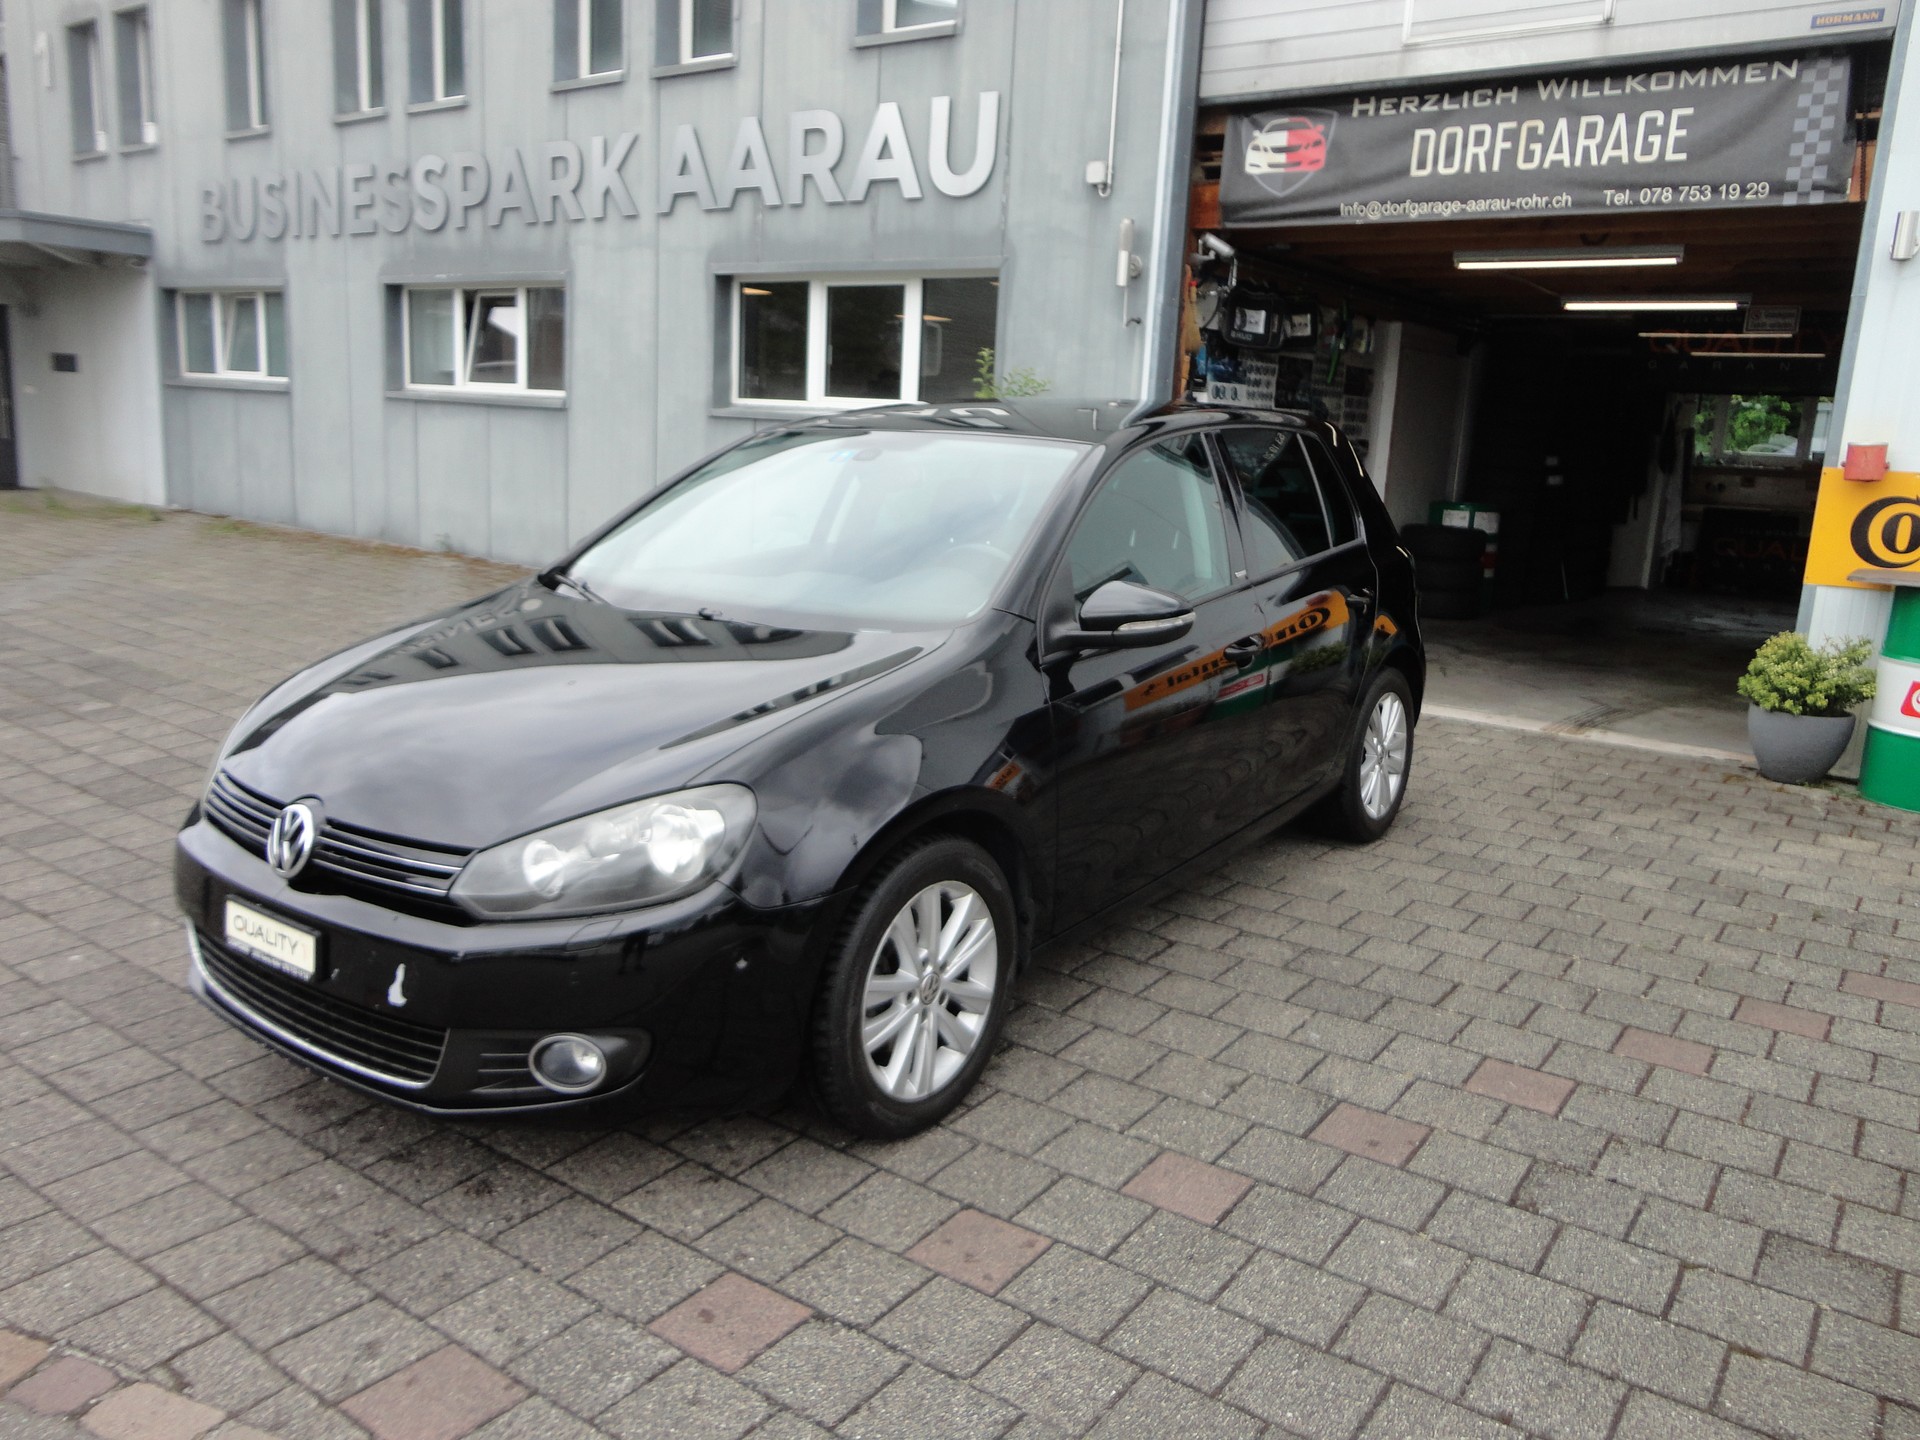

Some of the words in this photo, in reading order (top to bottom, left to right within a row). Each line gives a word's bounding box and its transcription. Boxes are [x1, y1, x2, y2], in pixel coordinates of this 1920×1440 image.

[1351, 85, 1518, 118] HERZLICH
[1537, 58, 1799, 102] WILLKOMMEN
[201, 131, 639, 243] BUSINESSPARK
[657, 91, 1000, 214] AARAU
[1410, 107, 1695, 177] DORFGARAGE
[1339, 191, 1572, 220] Info@dorfgarage-aarau-rohr.ch
[1603, 189, 1633, 206] Tel.
[1639, 187, 1673, 204] 078
[1678, 184, 1712, 202] 753
[1719, 183, 1741, 200] 19
[1745, 181, 1770, 199] 29
[233, 914, 298, 956] QUALITY
